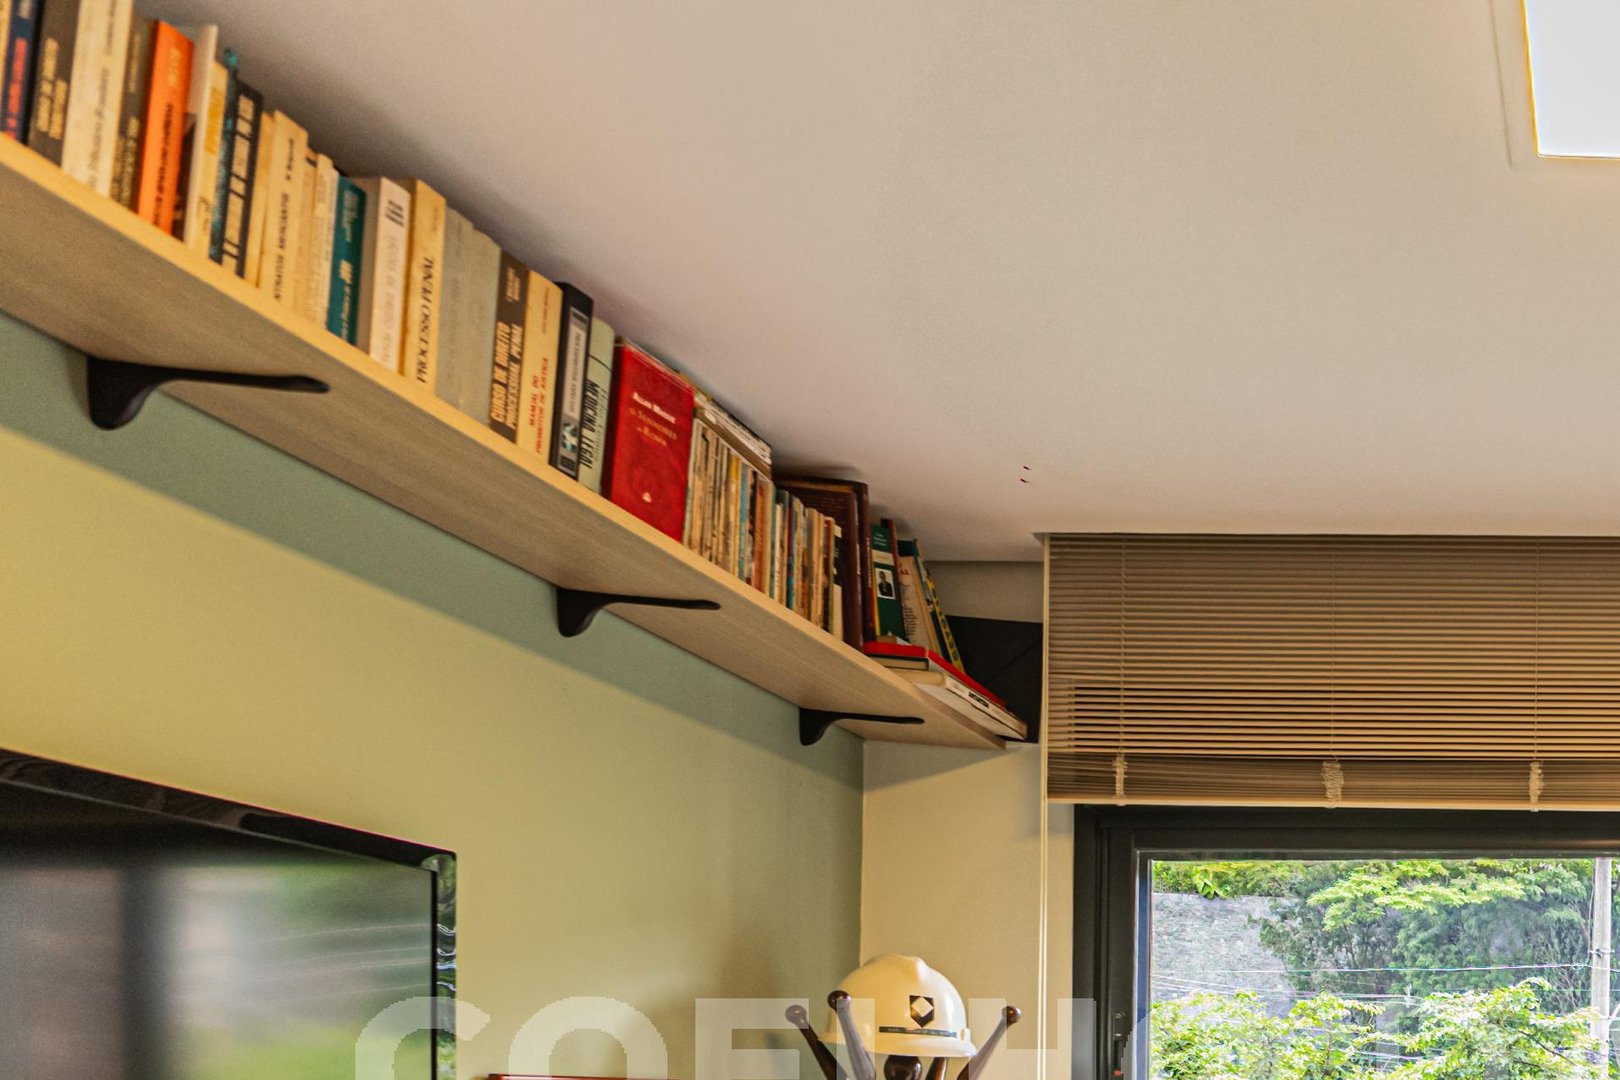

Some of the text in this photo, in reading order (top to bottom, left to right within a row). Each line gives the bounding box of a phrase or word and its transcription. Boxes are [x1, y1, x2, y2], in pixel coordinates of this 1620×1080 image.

[416, 256, 435, 384] PROCESSO PENAL
[490, 321, 511, 423] CURSO DE DIREITO
[579, 379, 600, 469] MEDICINA LEGAL
